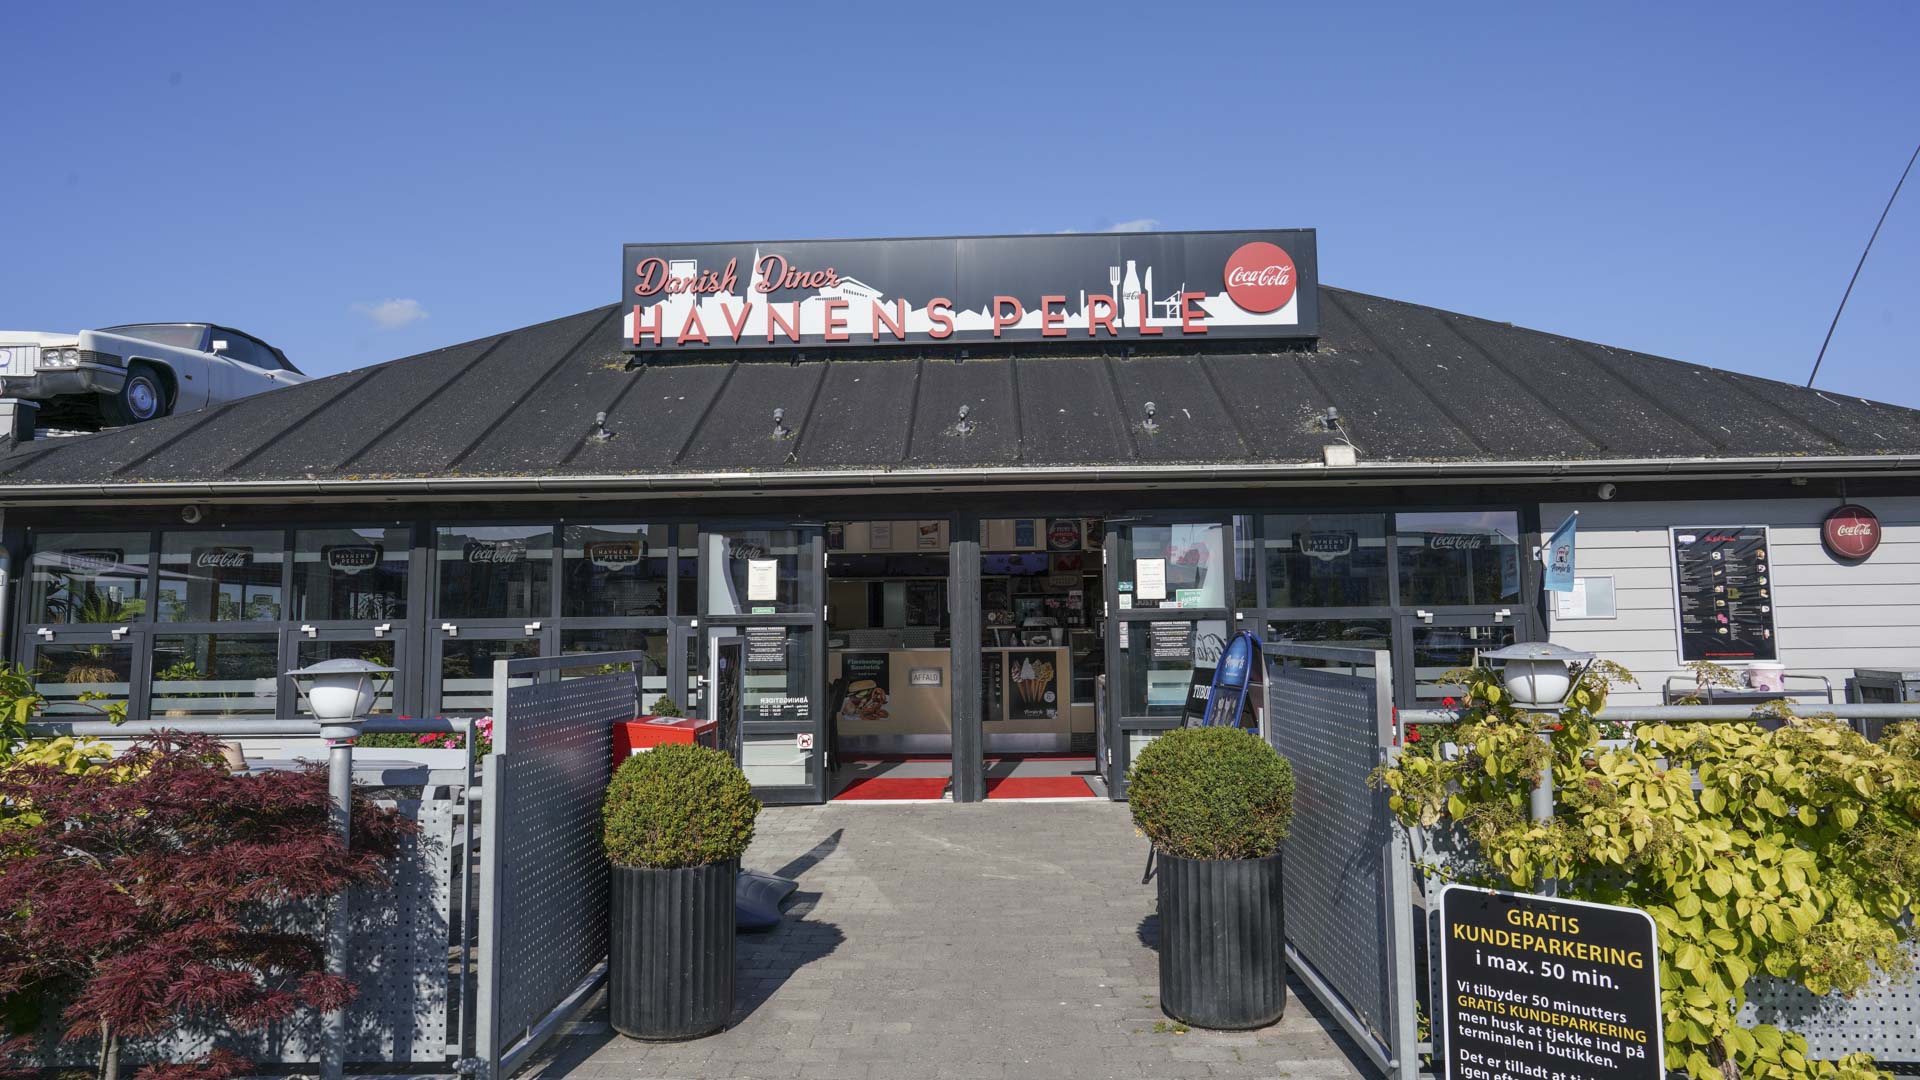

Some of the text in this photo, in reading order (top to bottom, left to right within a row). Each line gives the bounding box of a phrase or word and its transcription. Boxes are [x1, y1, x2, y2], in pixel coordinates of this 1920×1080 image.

[634, 254, 843, 297] Danish Diner
[1228, 265, 1292, 287] Coca-Cola
[632, 291, 1209, 346] HAVNENS PERLE
[1430, 535, 1482, 550] Coca-Cola
[1837, 523, 1872, 537] Coca-Cola
[197, 551, 245, 568] Coca-Cola
[913, 673, 938, 681] AFFALD
[1192, 684, 1212, 700] TUBO
[1506, 909, 1580, 934] GRATIS
[1453, 923, 1644, 969] KUNDEPARKERING
[1475, 949, 1619, 990] i max. 50 min.
[1457, 980, 1627, 1024] Vi tilbyder 50 minutters
[1457, 995, 1647, 1043] GRATIS KUNDEPARKERING
[1458, 1011, 1645, 1060] men husk at tjekke ind på
[1458, 1024, 1618, 1069] terminalen i butikken.
[1460, 1048, 1484, 1066] Det
[1487, 1056, 1501, 1068] er
[1505, 1059, 1549, 1080] tilladt
[1552, 1071, 1566, 1080] at
[1460, 1063, 1519, 1080] igen eft
